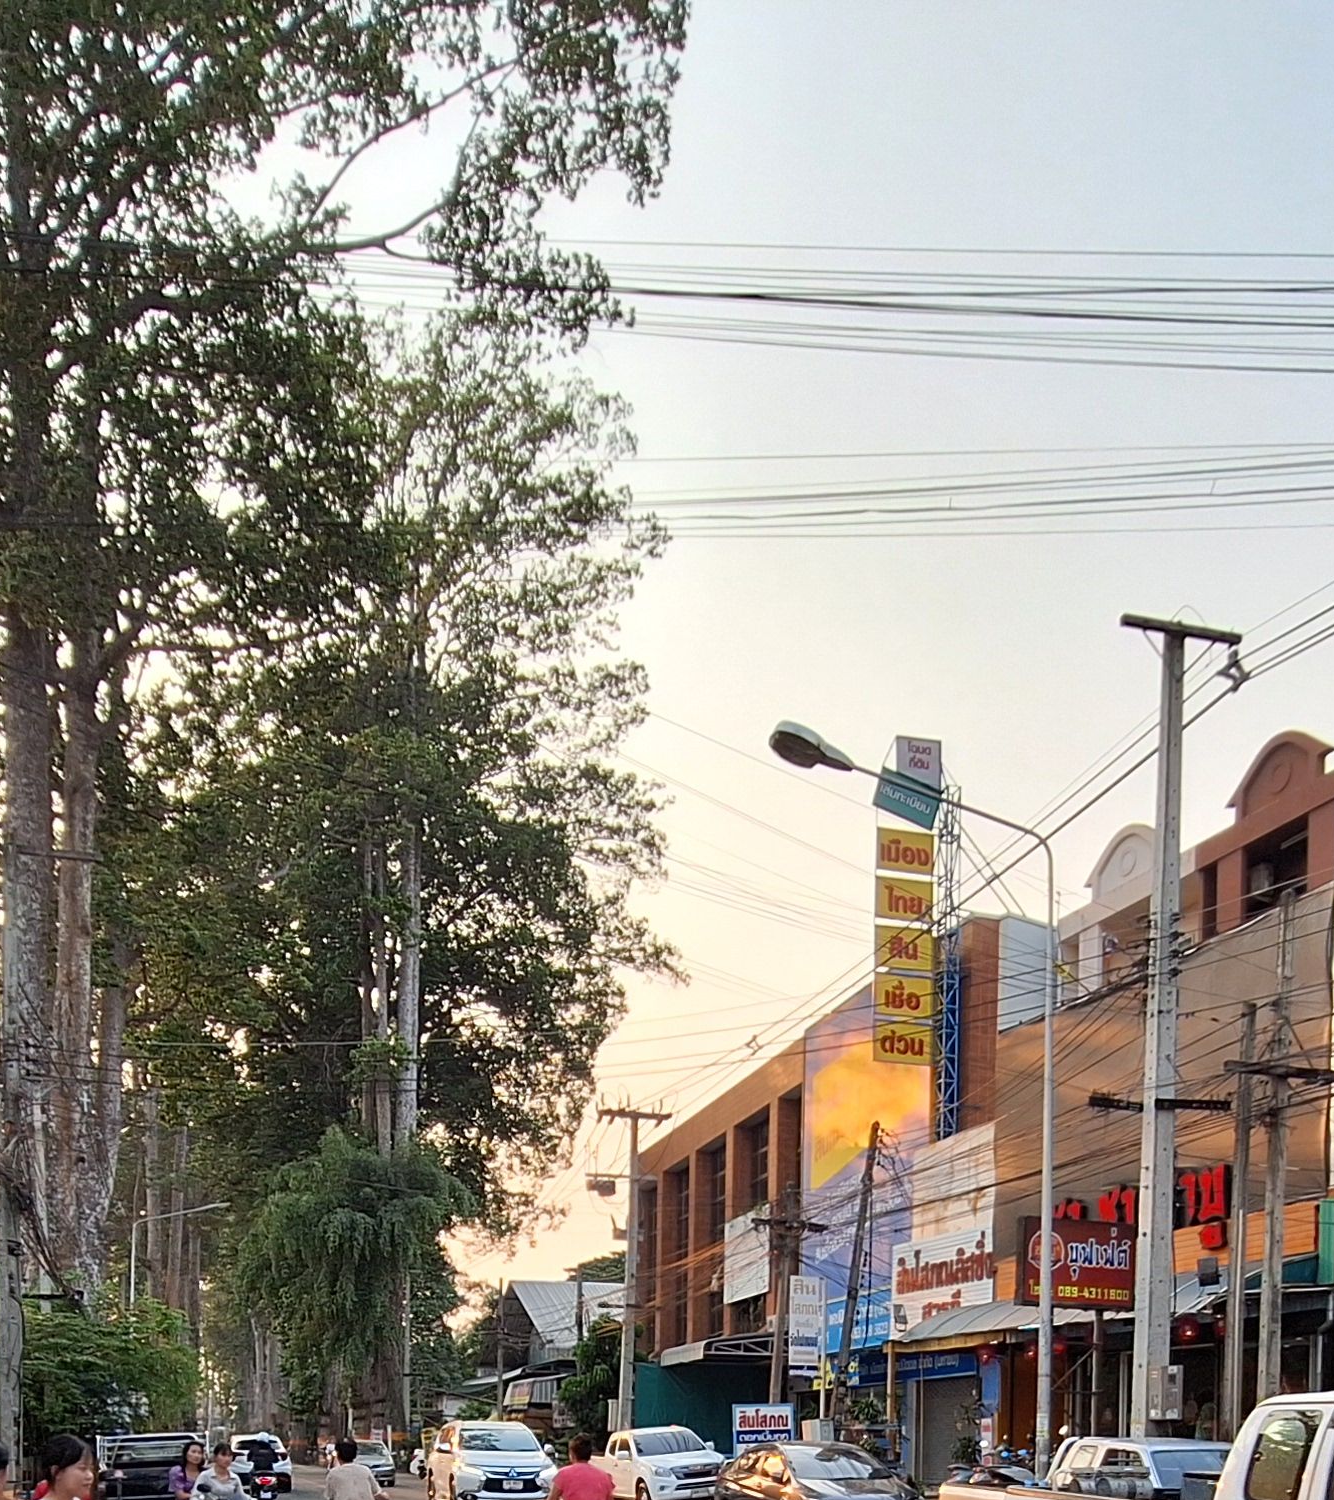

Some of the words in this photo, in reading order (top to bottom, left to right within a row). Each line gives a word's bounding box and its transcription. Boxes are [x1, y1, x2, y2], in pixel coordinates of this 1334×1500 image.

[880, 838, 930, 867] เมือง
[883, 883, 923, 915] ไทย
[889, 935, 919, 961] สิน
[884, 980, 921, 1011] เชื่อ
[880, 1029, 925, 1057] ด่วน
[738, 1408, 789, 1429] สินโสภณ
